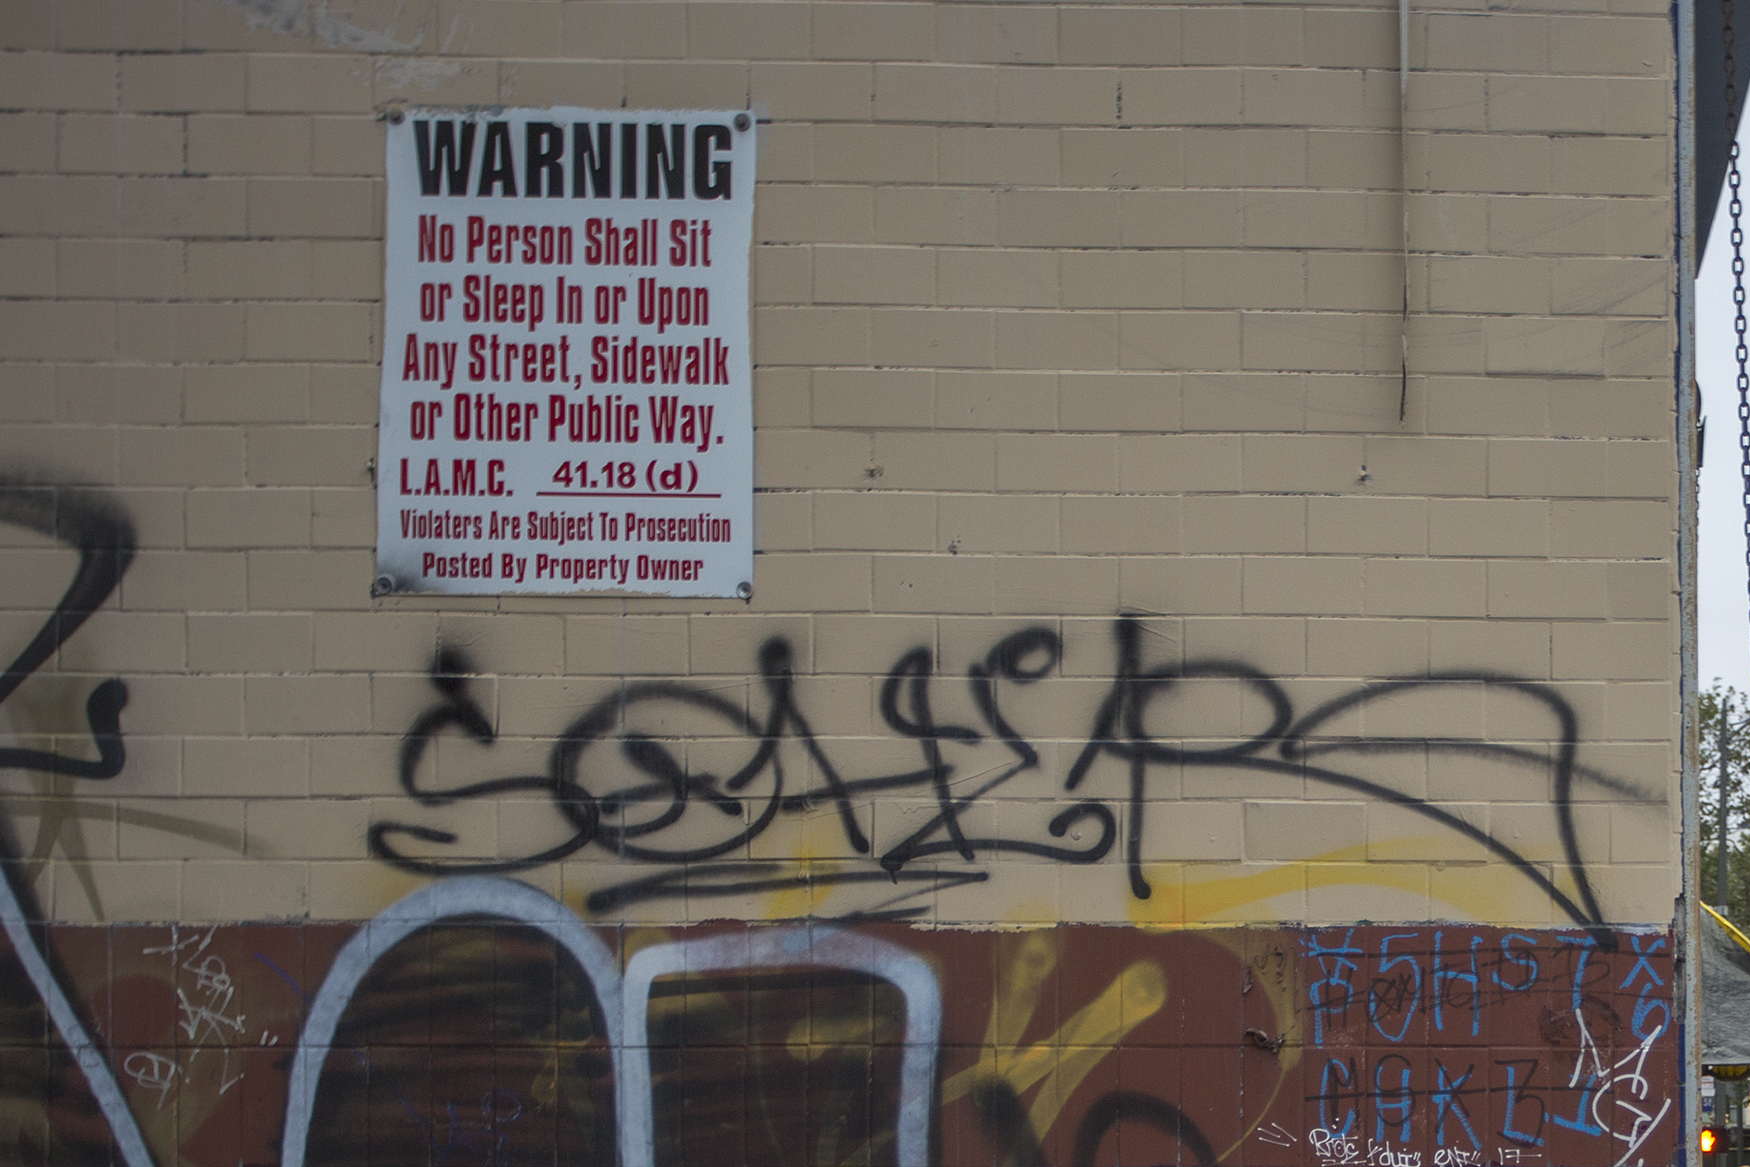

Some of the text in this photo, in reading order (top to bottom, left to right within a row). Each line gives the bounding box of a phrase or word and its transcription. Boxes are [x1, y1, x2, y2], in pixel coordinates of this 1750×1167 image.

[413, 119, 733, 201] WARNING
[418, 214, 712, 268] No Person Shall Sit
[420, 274, 709, 334] or Sleep In or Upon
[403, 333, 730, 391] Any Street, Sidewalk
[410, 392, 724, 454] or Other Public Way.
[400, 457, 700, 497] L.A.M.C. 41.18 (d)
[400, 509, 732, 547] Violaters Are Subject To Prosecution
[422, 552, 705, 585] Posted By Property Owner
